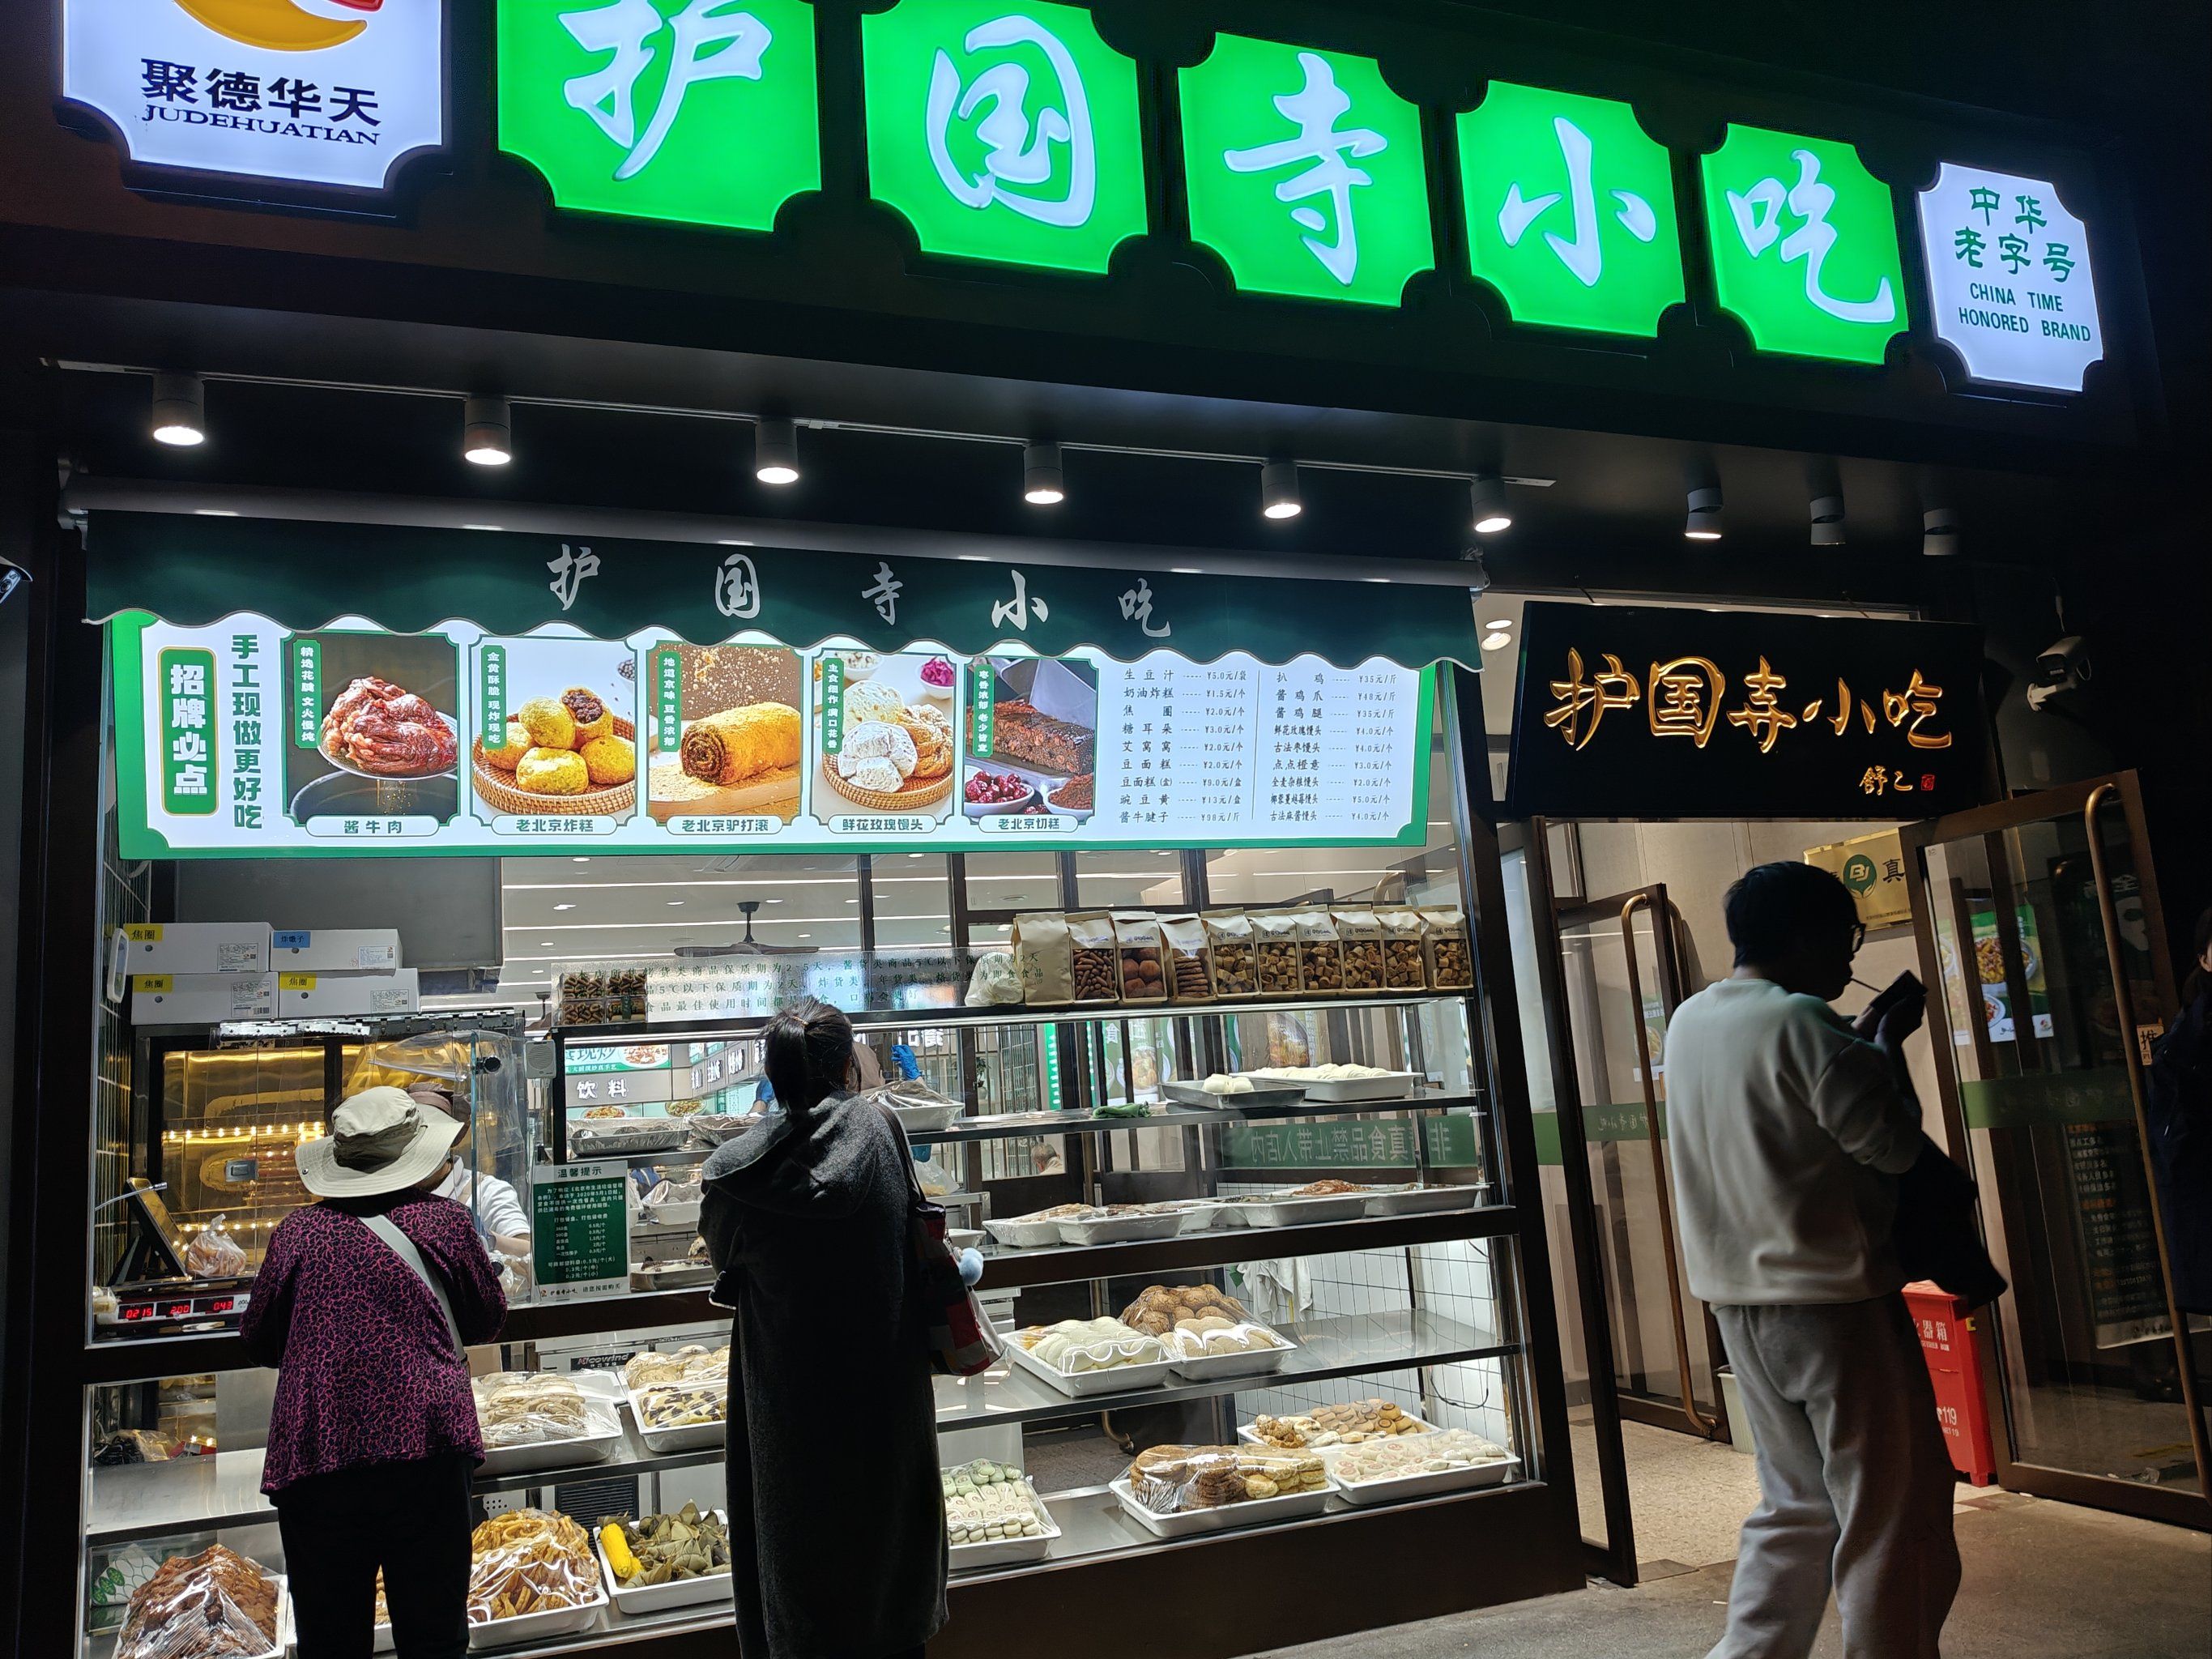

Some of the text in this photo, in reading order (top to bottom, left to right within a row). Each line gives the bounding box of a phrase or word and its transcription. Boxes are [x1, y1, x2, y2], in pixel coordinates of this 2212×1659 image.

[140, 58, 381, 126] 聚德华天
[142, 104, 381, 146] JUDEHUATIAN
[561, 0, 1897, 323] 护国寺小吃
[1967, 185, 2047, 234] 中华
[1954, 226, 2076, 283] 老字号
[1969, 282, 2064, 313] CHINA TIME
[1958, 306, 2092, 343] HONORED BRAND
[546, 544, 1171, 638] 护国寺小吃
[1124, 668, 1174, 681] 生豆汁
[1276, 672, 1324, 684] 扒鸡
[487, 651, 501, 744] 金黄酥脆 现炸现吃
[1123, 688, 1174, 698] 奶油炸糕
[1276, 690, 1323, 702] 酱鸡爪
[1544, 646, 1952, 753] 护国寺小吃
[663, 657, 676, 748] 地道京味 豆香浓郁
[301, 697, 316, 743] 文火慢炖
[1276, 707, 1323, 719] 酱鸡腿
[170, 663, 207, 795] 招牌必点
[231, 633, 263, 830] 手工现做更好吃
[1122, 723, 1172, 735] 糖耳朵
[1274, 725, 1322, 736] 鲜花玫瑰馒头
[1122, 741, 1171, 753] 艾窝窝
[1273, 742, 1320, 753] 古法枣馒头
[1122, 759, 1171, 770] 豆面糕
[1272, 777, 1319, 787] 全麦杂粮馒头
[1120, 794, 1170, 805] 豌豆黄
[997, 817, 1060, 830] 老北京切糕
[1119, 812, 1169, 823] 酱牛腱子
[1270, 812, 1317, 821] 古法麻酱馒头
[343, 820, 403, 834] 酱牛肉
[515, 818, 594, 833] 老北京炸糕
[681, 818, 769, 833] 老北京驴打滚
[842, 817, 924, 831] 鲜花玫瑰馒头
[1882, 858, 1905, 883] 真
[132, 928, 155, 940] 焦圈
[577, 1078, 629, 1099] 饮料
[558, 1166, 601, 1178] 温馨提示
